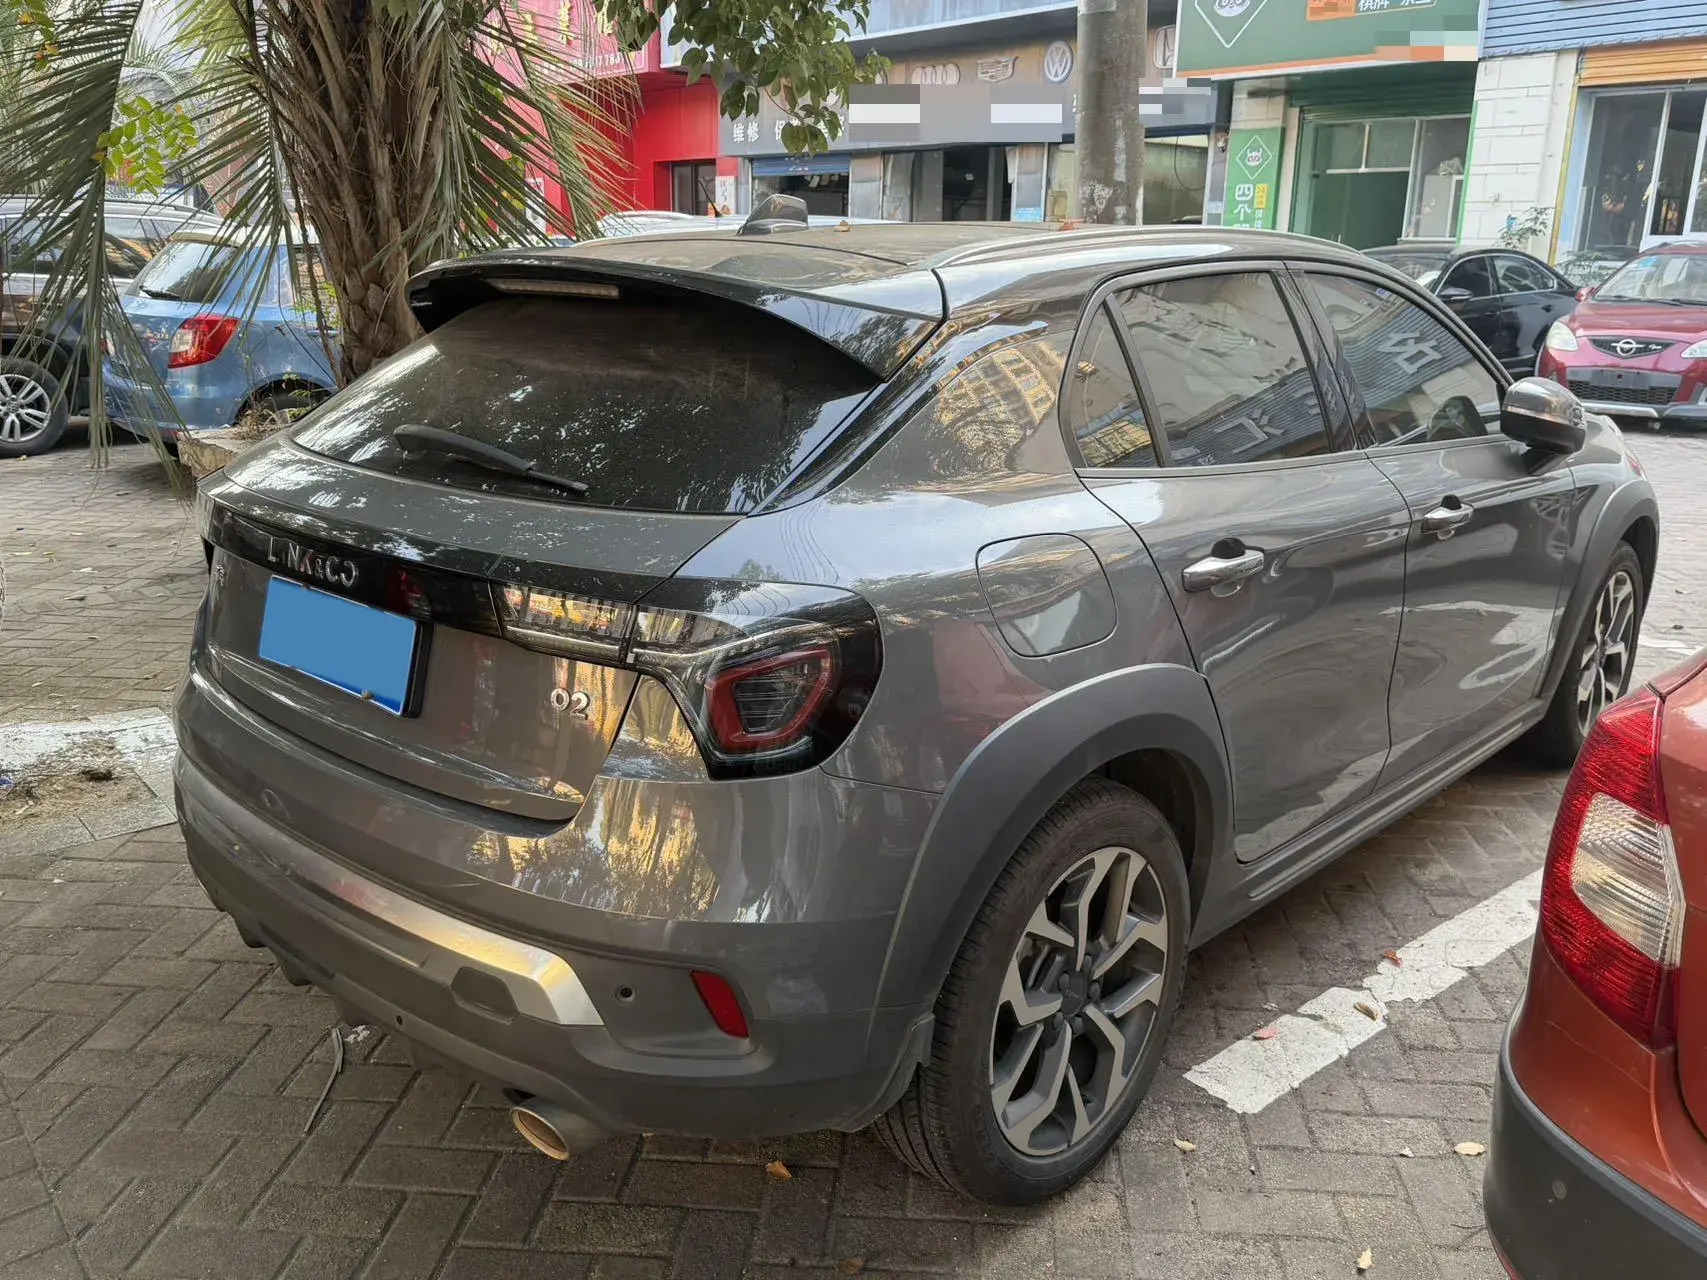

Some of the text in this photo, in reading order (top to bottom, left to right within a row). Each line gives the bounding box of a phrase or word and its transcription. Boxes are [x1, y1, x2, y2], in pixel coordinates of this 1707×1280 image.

[733, 121, 760, 142] 维修
[1233, 184, 1253, 229] 四个
[267, 536, 359, 588] LNK&CO
[550, 687, 589, 720] 02
